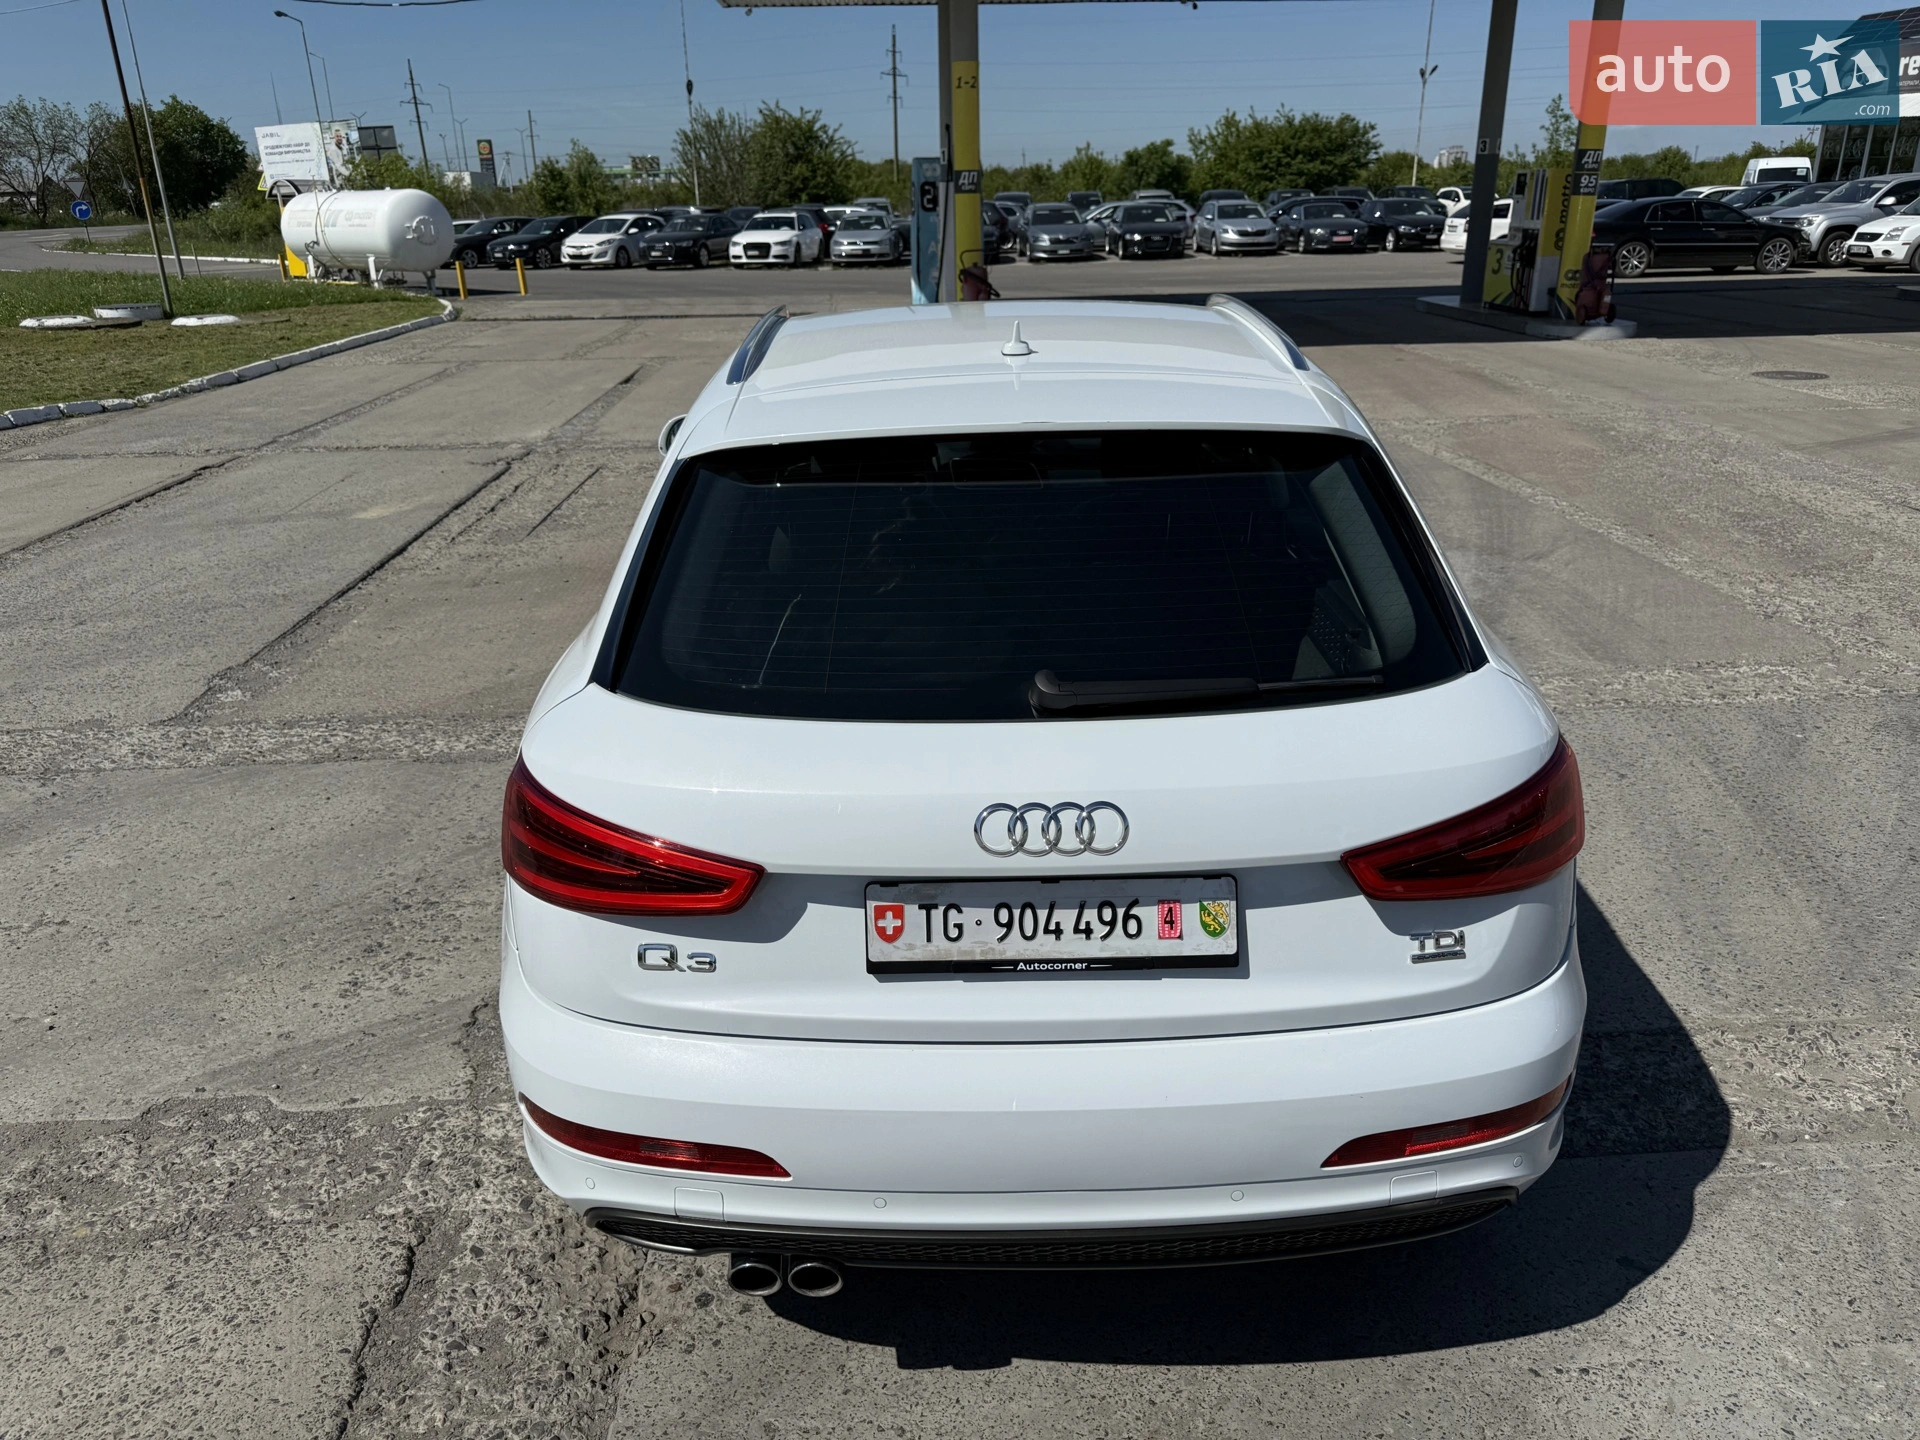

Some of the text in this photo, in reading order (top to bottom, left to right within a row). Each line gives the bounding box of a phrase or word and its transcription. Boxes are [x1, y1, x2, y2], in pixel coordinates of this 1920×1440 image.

[955, 76, 978, 89] 1-2
[1480, 140, 1488, 153] 3
[958, 171, 978, 186] ДП
[1579, 175, 1597, 188] 95
[923, 185, 935, 209] 2
[1491, 247, 1504, 275] 3
[917, 903, 964, 943] TG
[1163, 906, 1176, 930] 4
[1409, 929, 1466, 953] TDI
[637, 943, 717, 973] Q3
[1016, 960, 1088, 972] Autocorner
